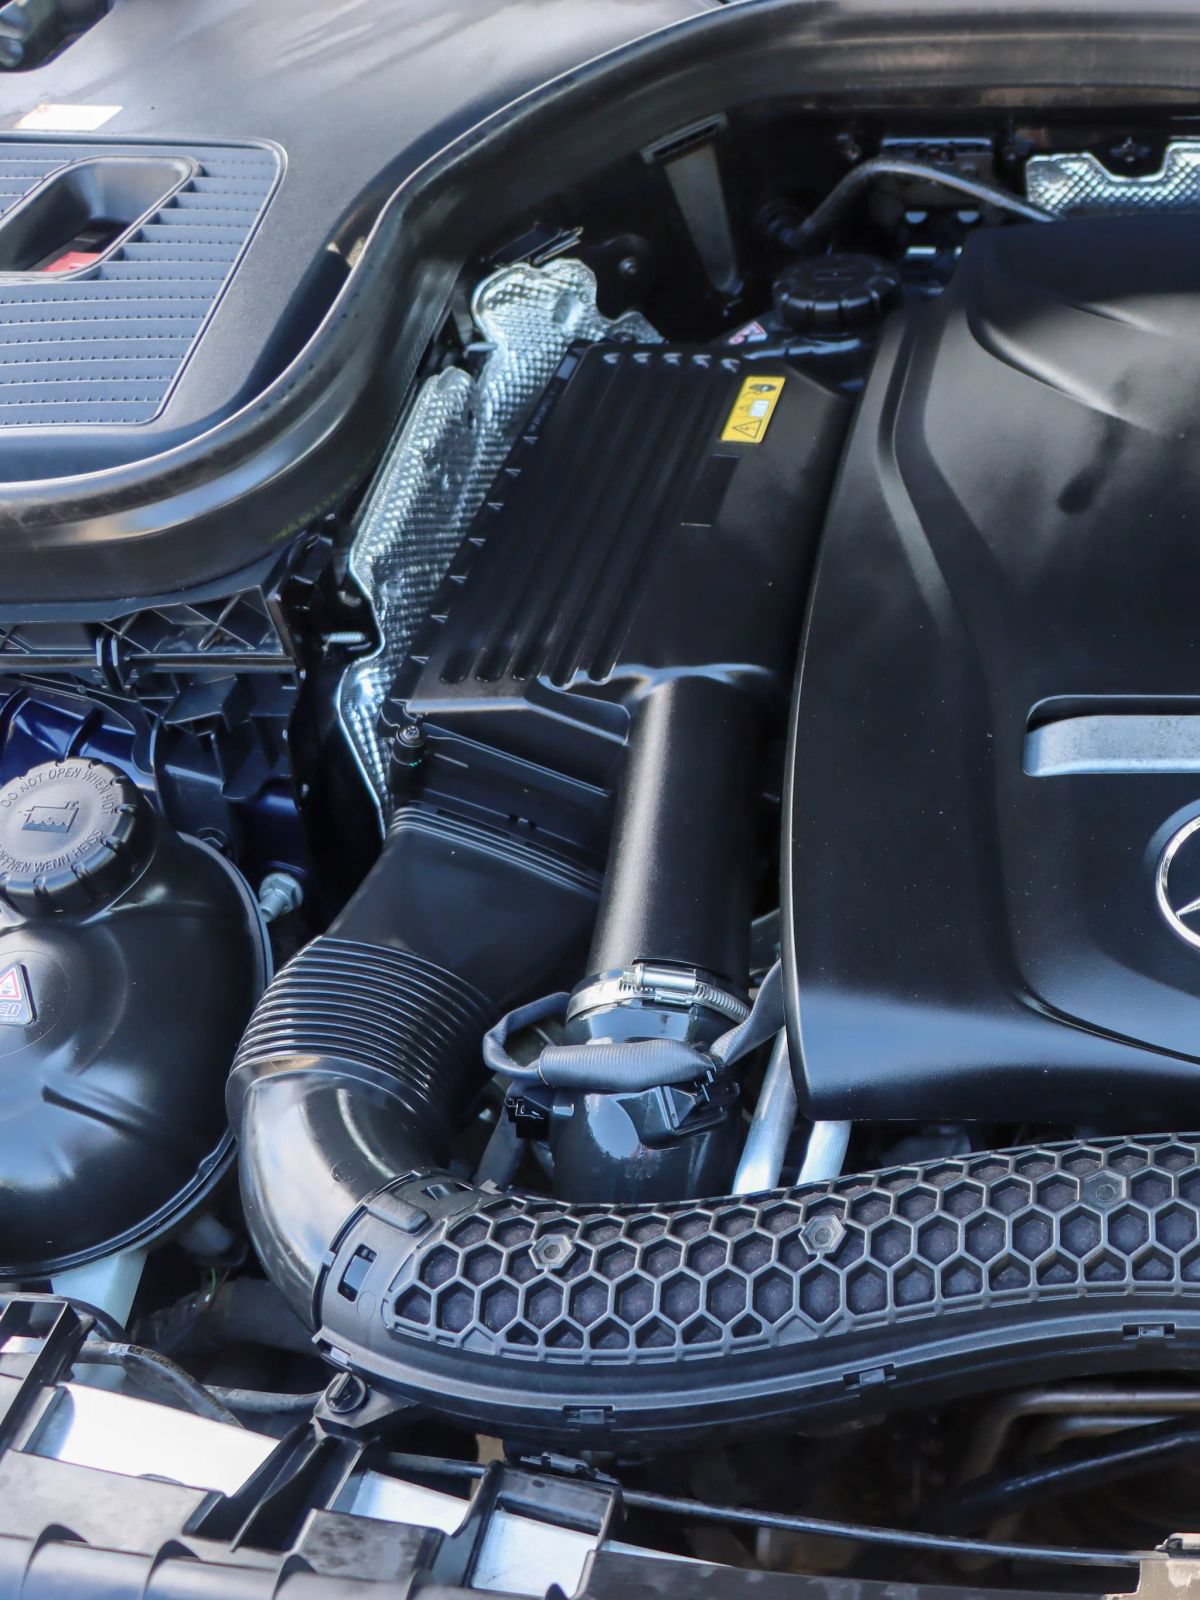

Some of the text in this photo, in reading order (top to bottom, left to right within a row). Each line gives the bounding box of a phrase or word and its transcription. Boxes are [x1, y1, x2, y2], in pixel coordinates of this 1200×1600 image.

[0, 791, 18, 808] DO
[20, 773, 43, 793] NOT
[48, 767, 82, 780] OPEN
[82, 769, 111, 795] WHEN
[34, 853, 71, 873] WENN
[72, 828, 104, 858] HEISS
